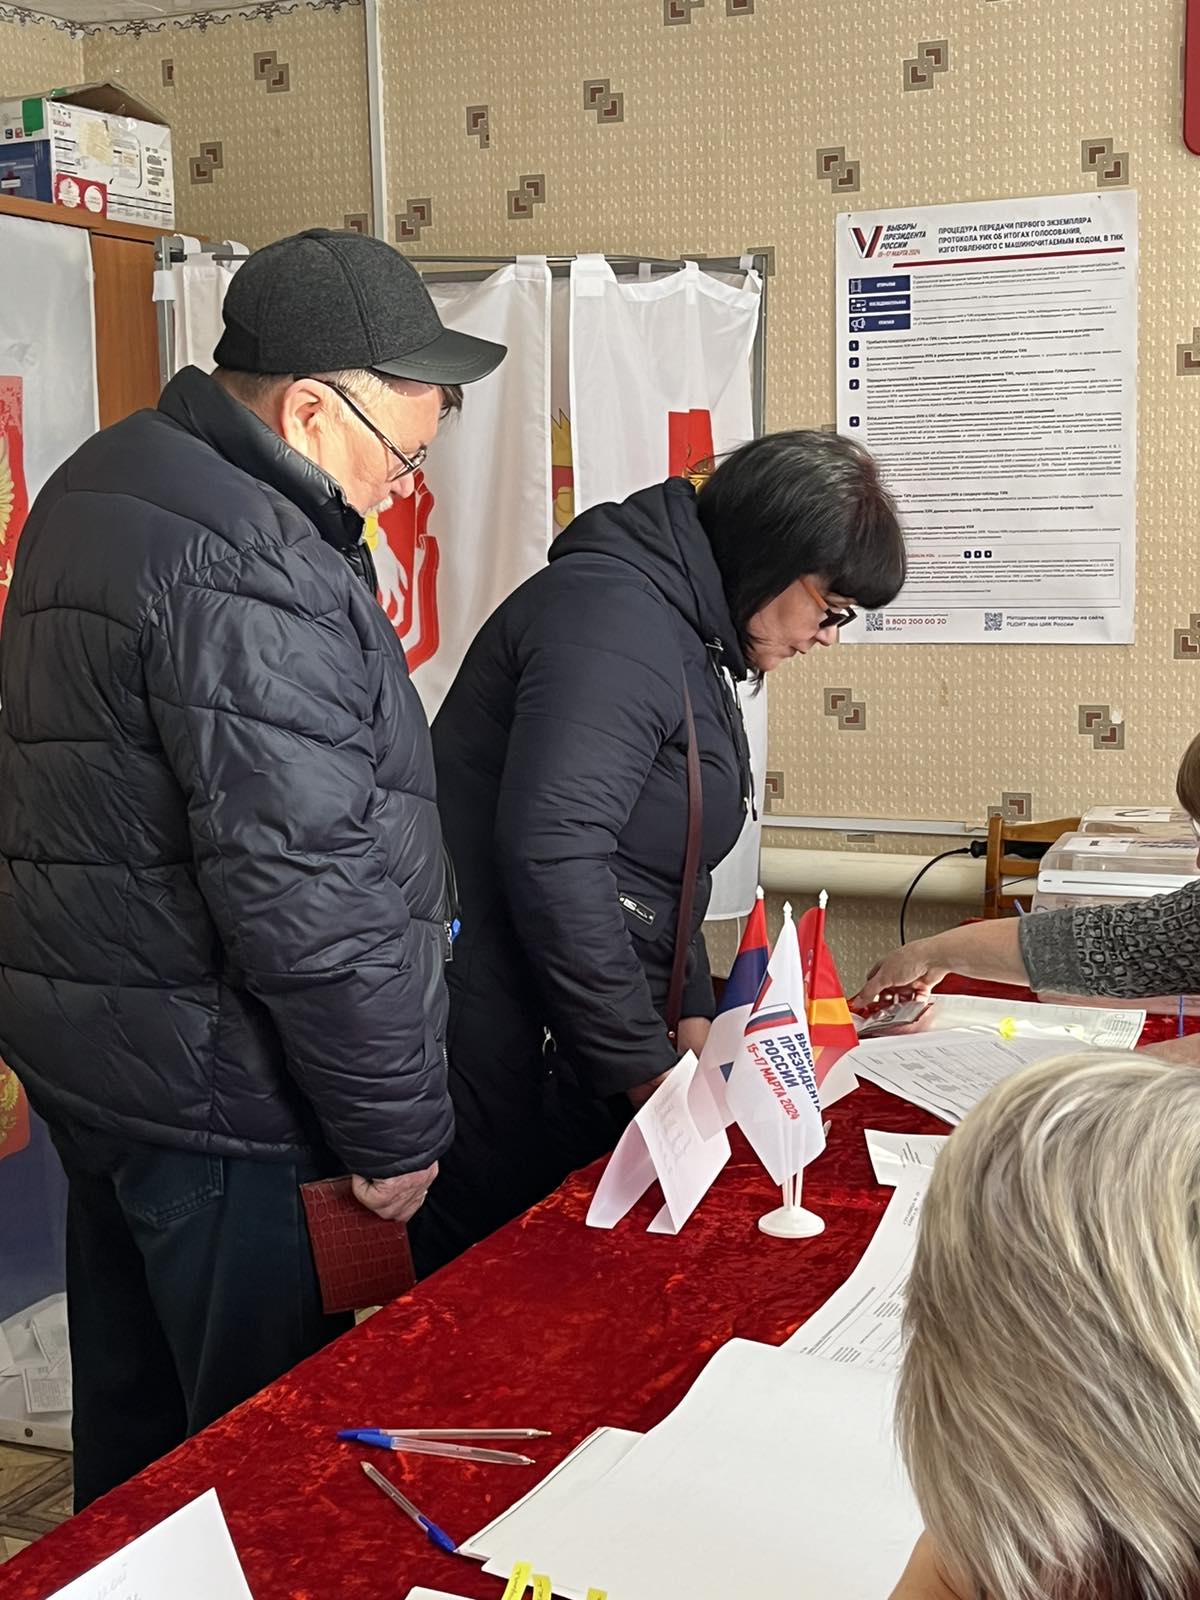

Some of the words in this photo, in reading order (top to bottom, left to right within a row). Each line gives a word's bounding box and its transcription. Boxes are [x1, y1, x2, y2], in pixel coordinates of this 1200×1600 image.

[886, 223, 917, 232] ВЫБОРЫ
[938, 226, 977, 234] ПРОЦЕДУРА
[979, 223, 1014, 231] ПЕРЕДАЧИ
[1015, 220, 1045, 229] ПЕРВОГО
[1047, 217, 1092, 226] ЭКЗЕМПЛЯРА
[884, 231, 926, 241] ПРЕЗИДЕНТА
[938, 235, 978, 244] ПРОТОКОЛА
[1003, 231, 1030, 239] ИТОГАХ
[1031, 227, 1081, 237] ГОЛОСОВАНИЯ,
[938, 243, 998, 253] ИЗГОТОВЛЕННОГО
[1004, 238, 1074, 249] МАШИНОЧИТАЕМЫМ
[1075, 235, 1102, 244] КОДОМ,
[1110, 233, 1124, 241] ТИК
[880, 241, 908, 250] РОССИИ
[760, 1038, 800, 1088] РОССИИ
[760, 1066, 787, 1098] МАРТА
[780, 1097, 801, 1120] 2024
